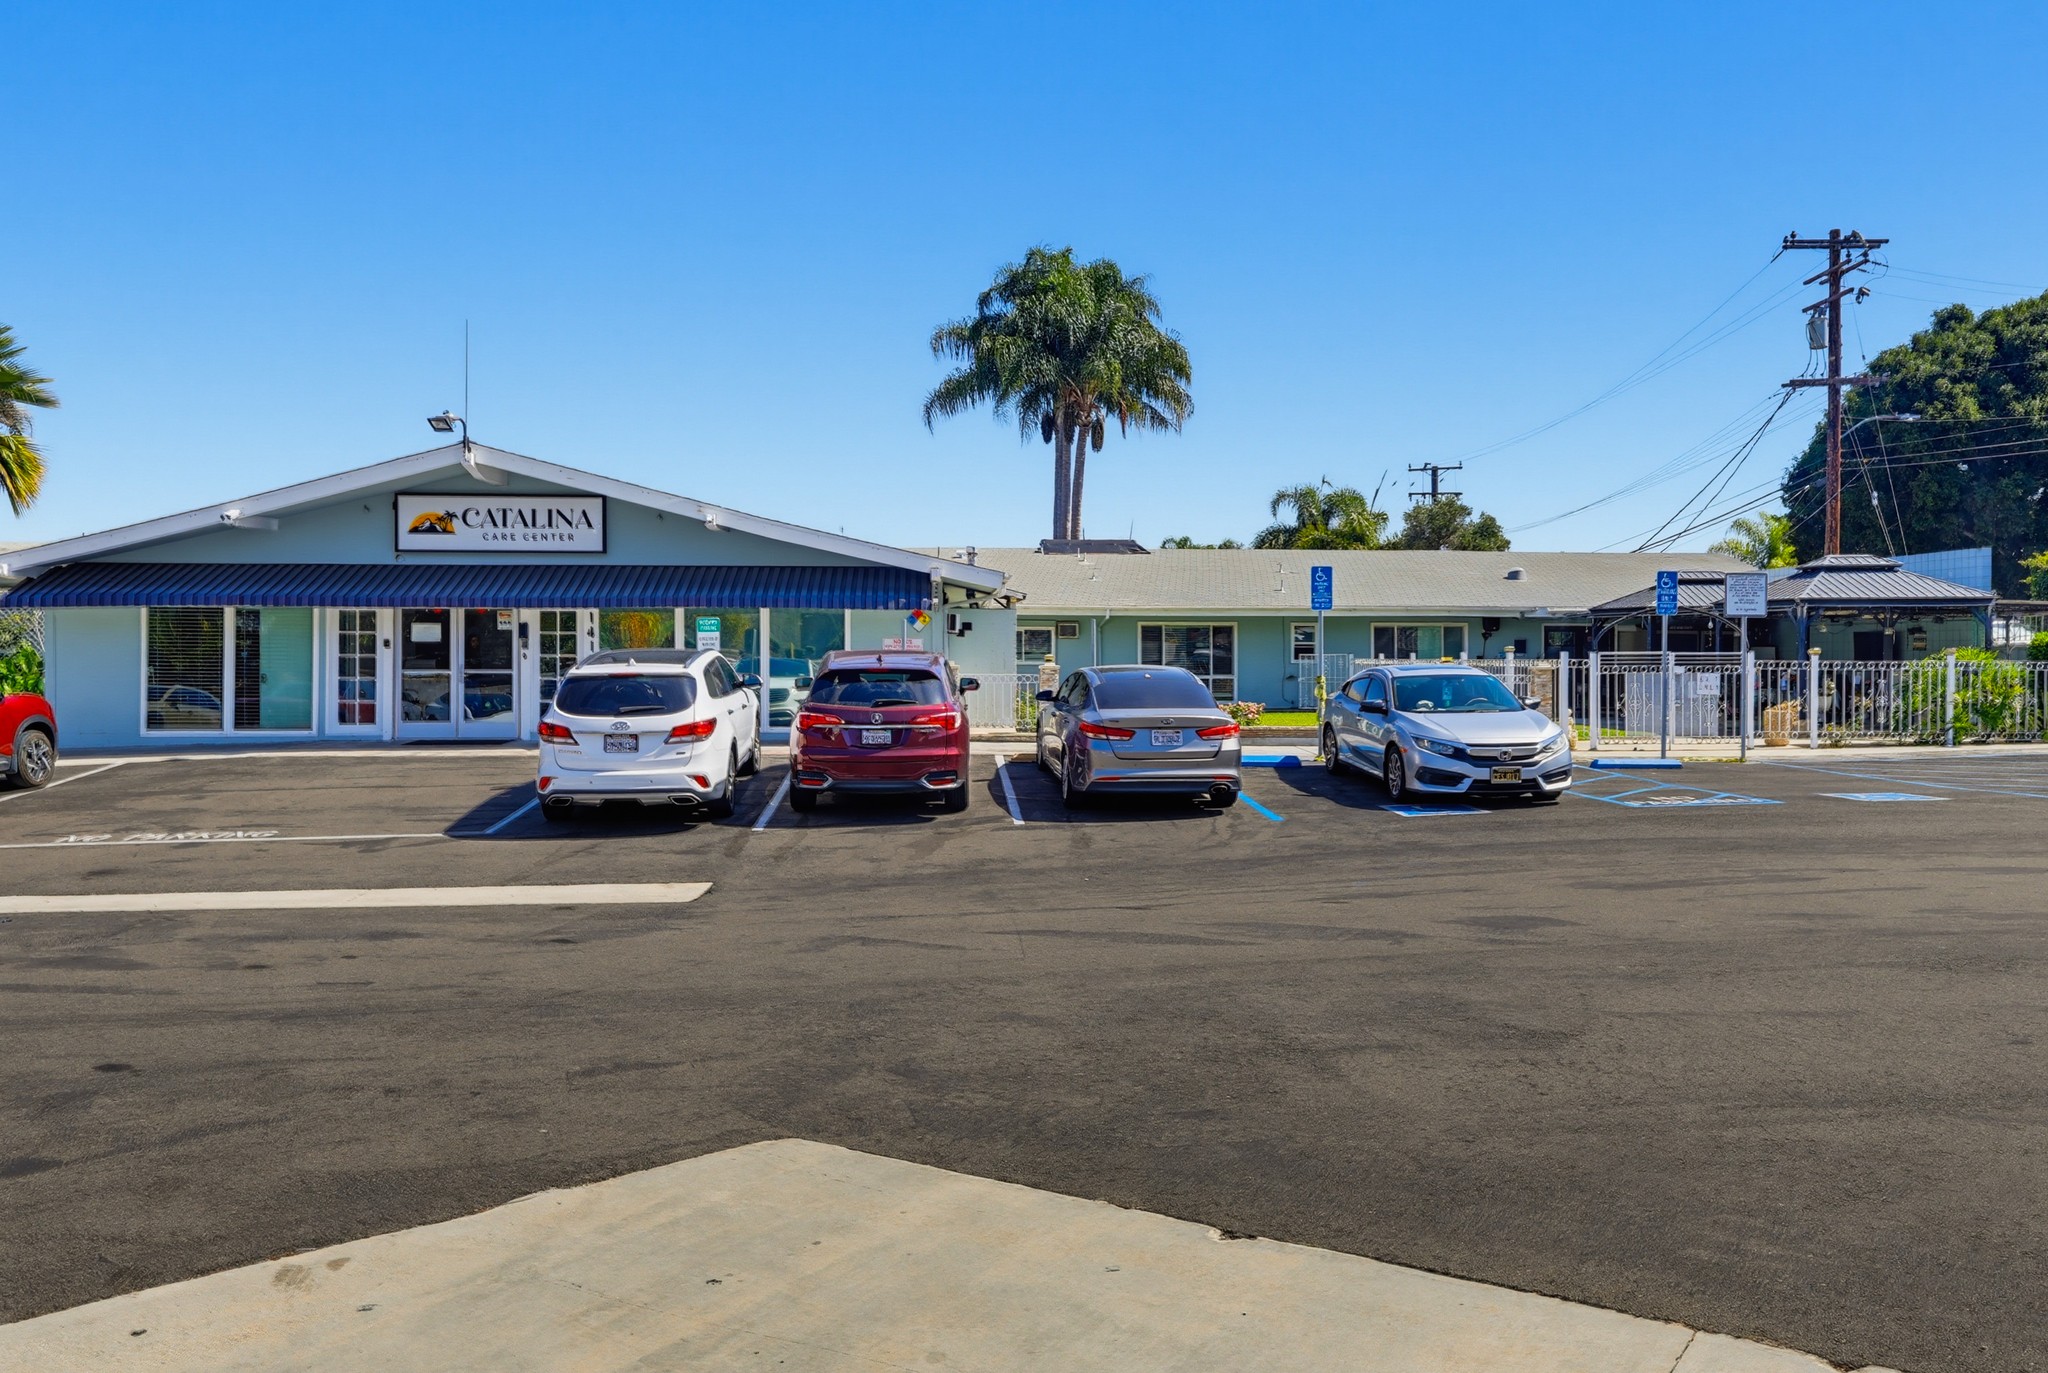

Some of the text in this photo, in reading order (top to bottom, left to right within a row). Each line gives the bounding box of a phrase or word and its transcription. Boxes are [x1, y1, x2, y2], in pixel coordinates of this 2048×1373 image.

[461, 507, 596, 530] CATALINA
[482, 532, 575, 542] CARE CENTER
[53, 829, 280, 844] NO PARKING
